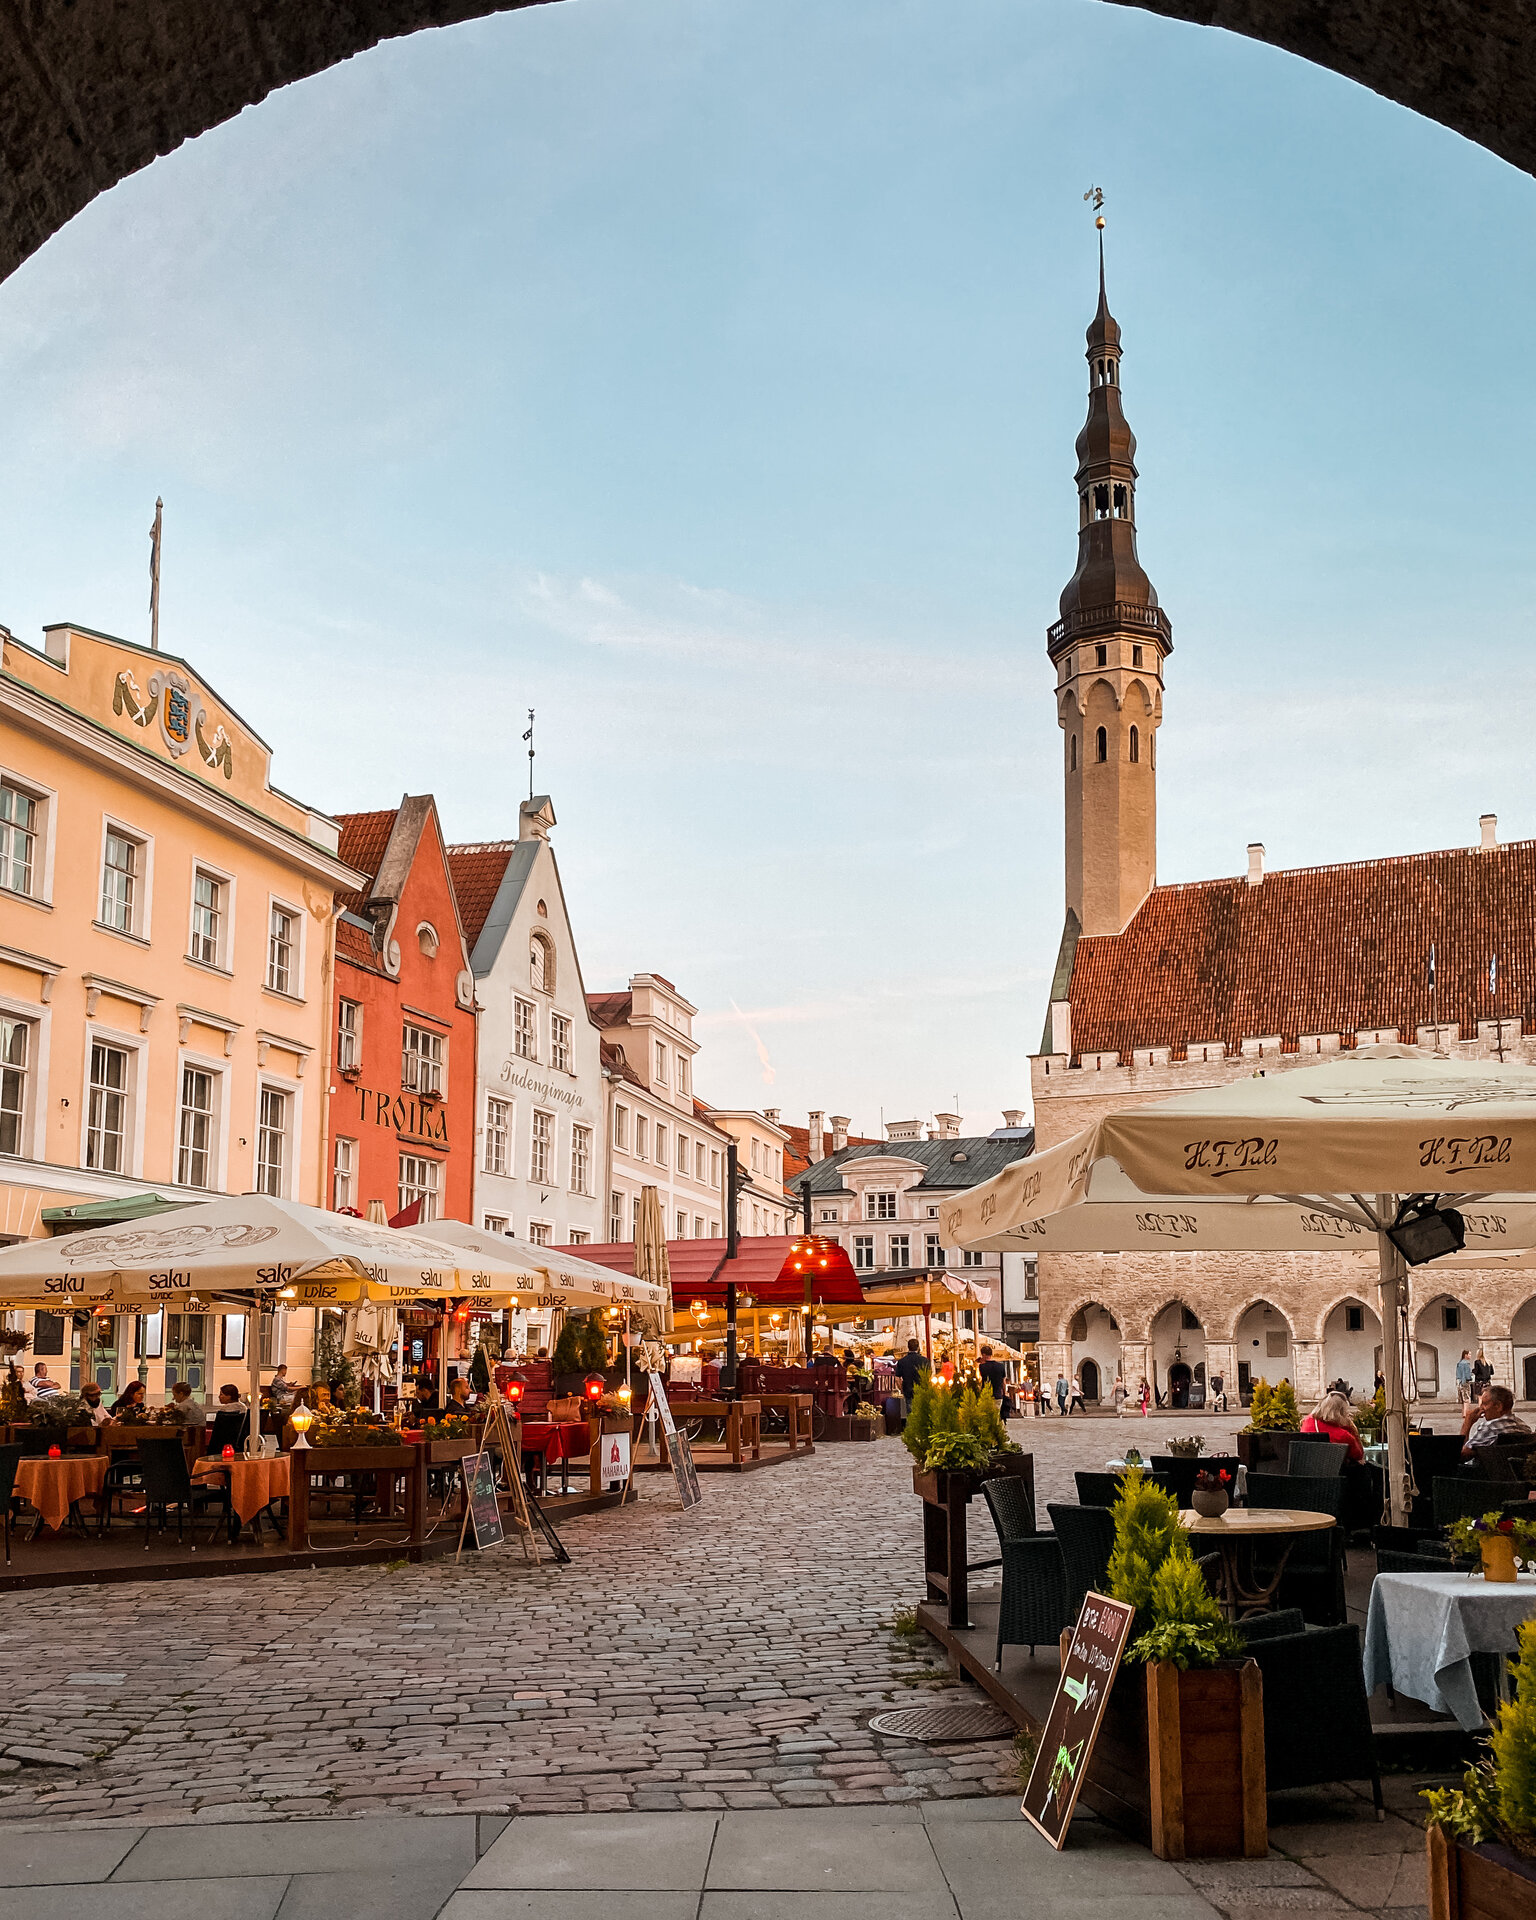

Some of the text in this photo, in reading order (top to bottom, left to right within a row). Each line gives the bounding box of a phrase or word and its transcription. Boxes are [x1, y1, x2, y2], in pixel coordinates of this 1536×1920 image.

[500, 1060, 585, 1113] Tudengimaja
[354, 1086, 449, 1142] TROIKA
[1234, 1137, 1279, 1166] Puls
[1469, 1135, 1512, 1164] Puls
[43, 1273, 85, 1293] saku
[148, 1268, 191, 1290] saku
[420, 1268, 443, 1287] saku
[471, 1270, 491, 1289] saku
[516, 1273, 534, 1290] saku
[559, 1271, 575, 1288] saku
[592, 1278, 606, 1294] saku
[354, 1330, 373, 1344] aku
